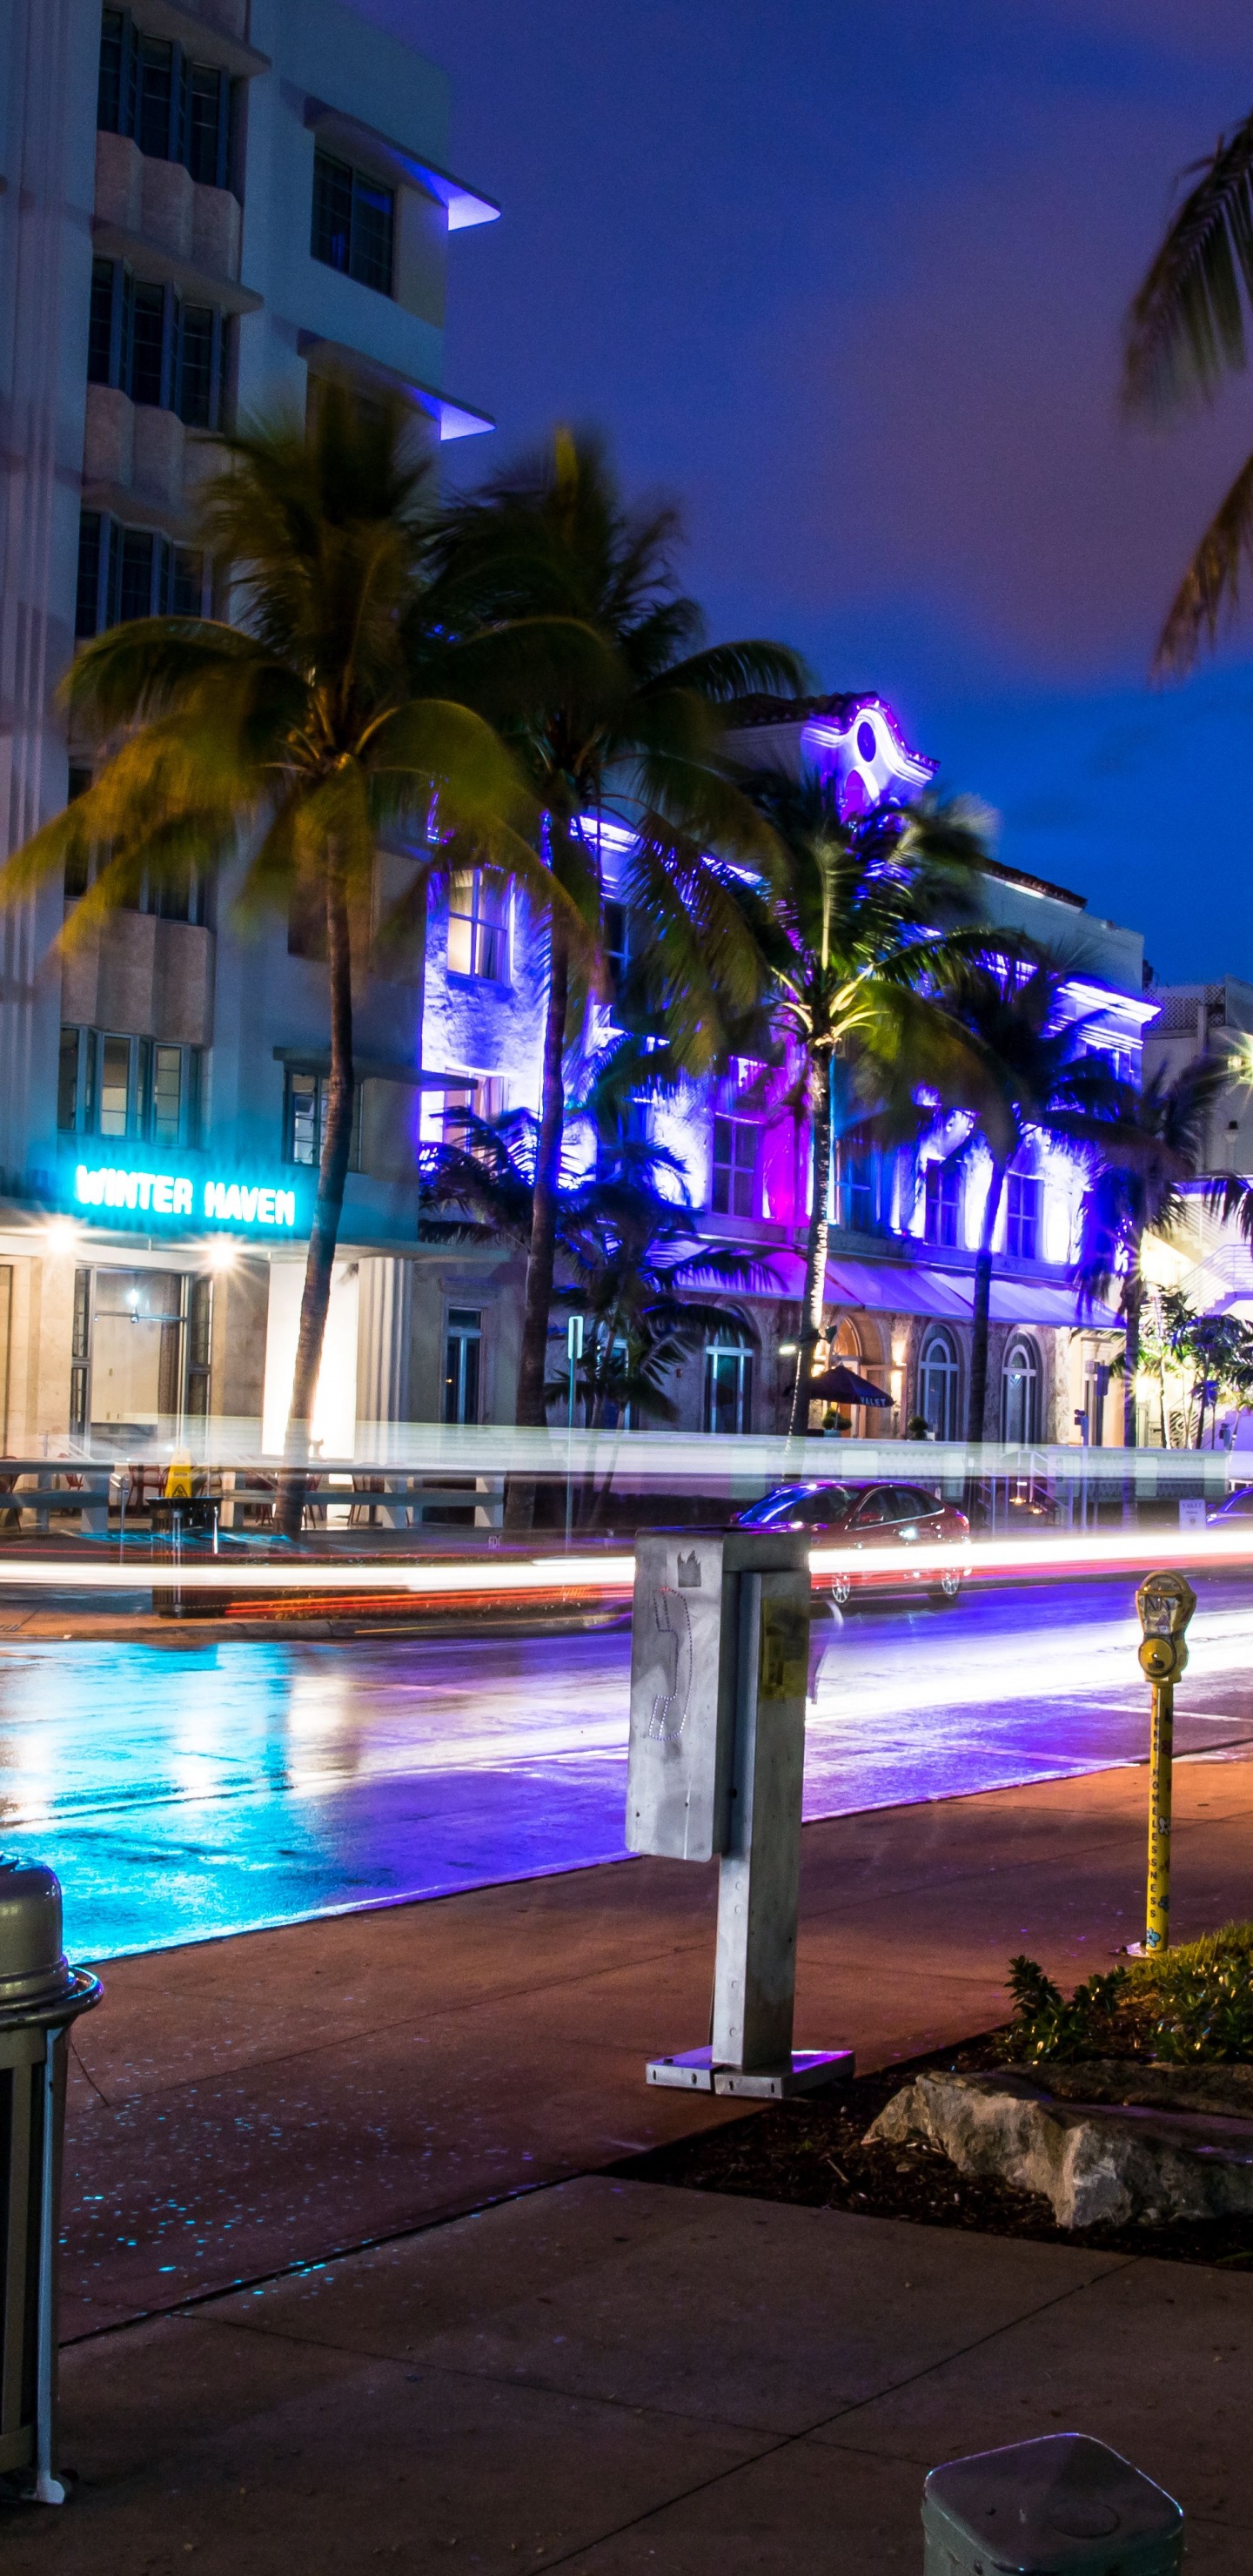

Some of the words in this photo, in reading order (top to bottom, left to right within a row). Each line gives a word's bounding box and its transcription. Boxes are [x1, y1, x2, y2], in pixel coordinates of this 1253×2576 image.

[77, 1164, 193, 1215] WINTER
[204, 1181, 295, 1226] HAVEN
[860, 1396, 886, 1406] VALET
[1149, 1768, 1159, 1918] HOMELESSNESS
